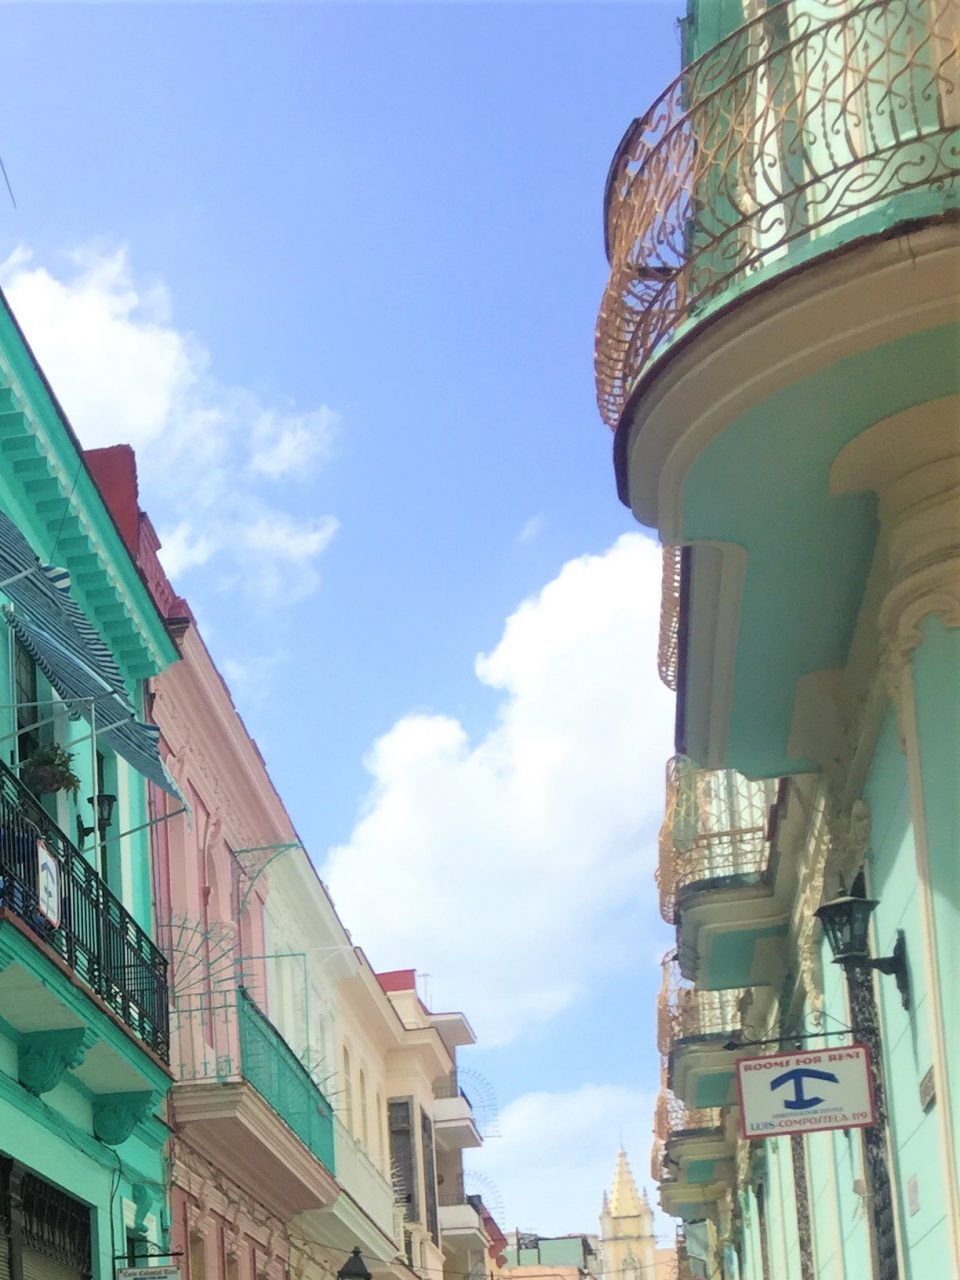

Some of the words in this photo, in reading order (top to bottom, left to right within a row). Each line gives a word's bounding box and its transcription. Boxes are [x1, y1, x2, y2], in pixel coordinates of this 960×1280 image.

[743, 1060, 790, 1072] ROOMS
[795, 1055, 822, 1066] FOR
[828, 1052, 860, 1062] RENT
